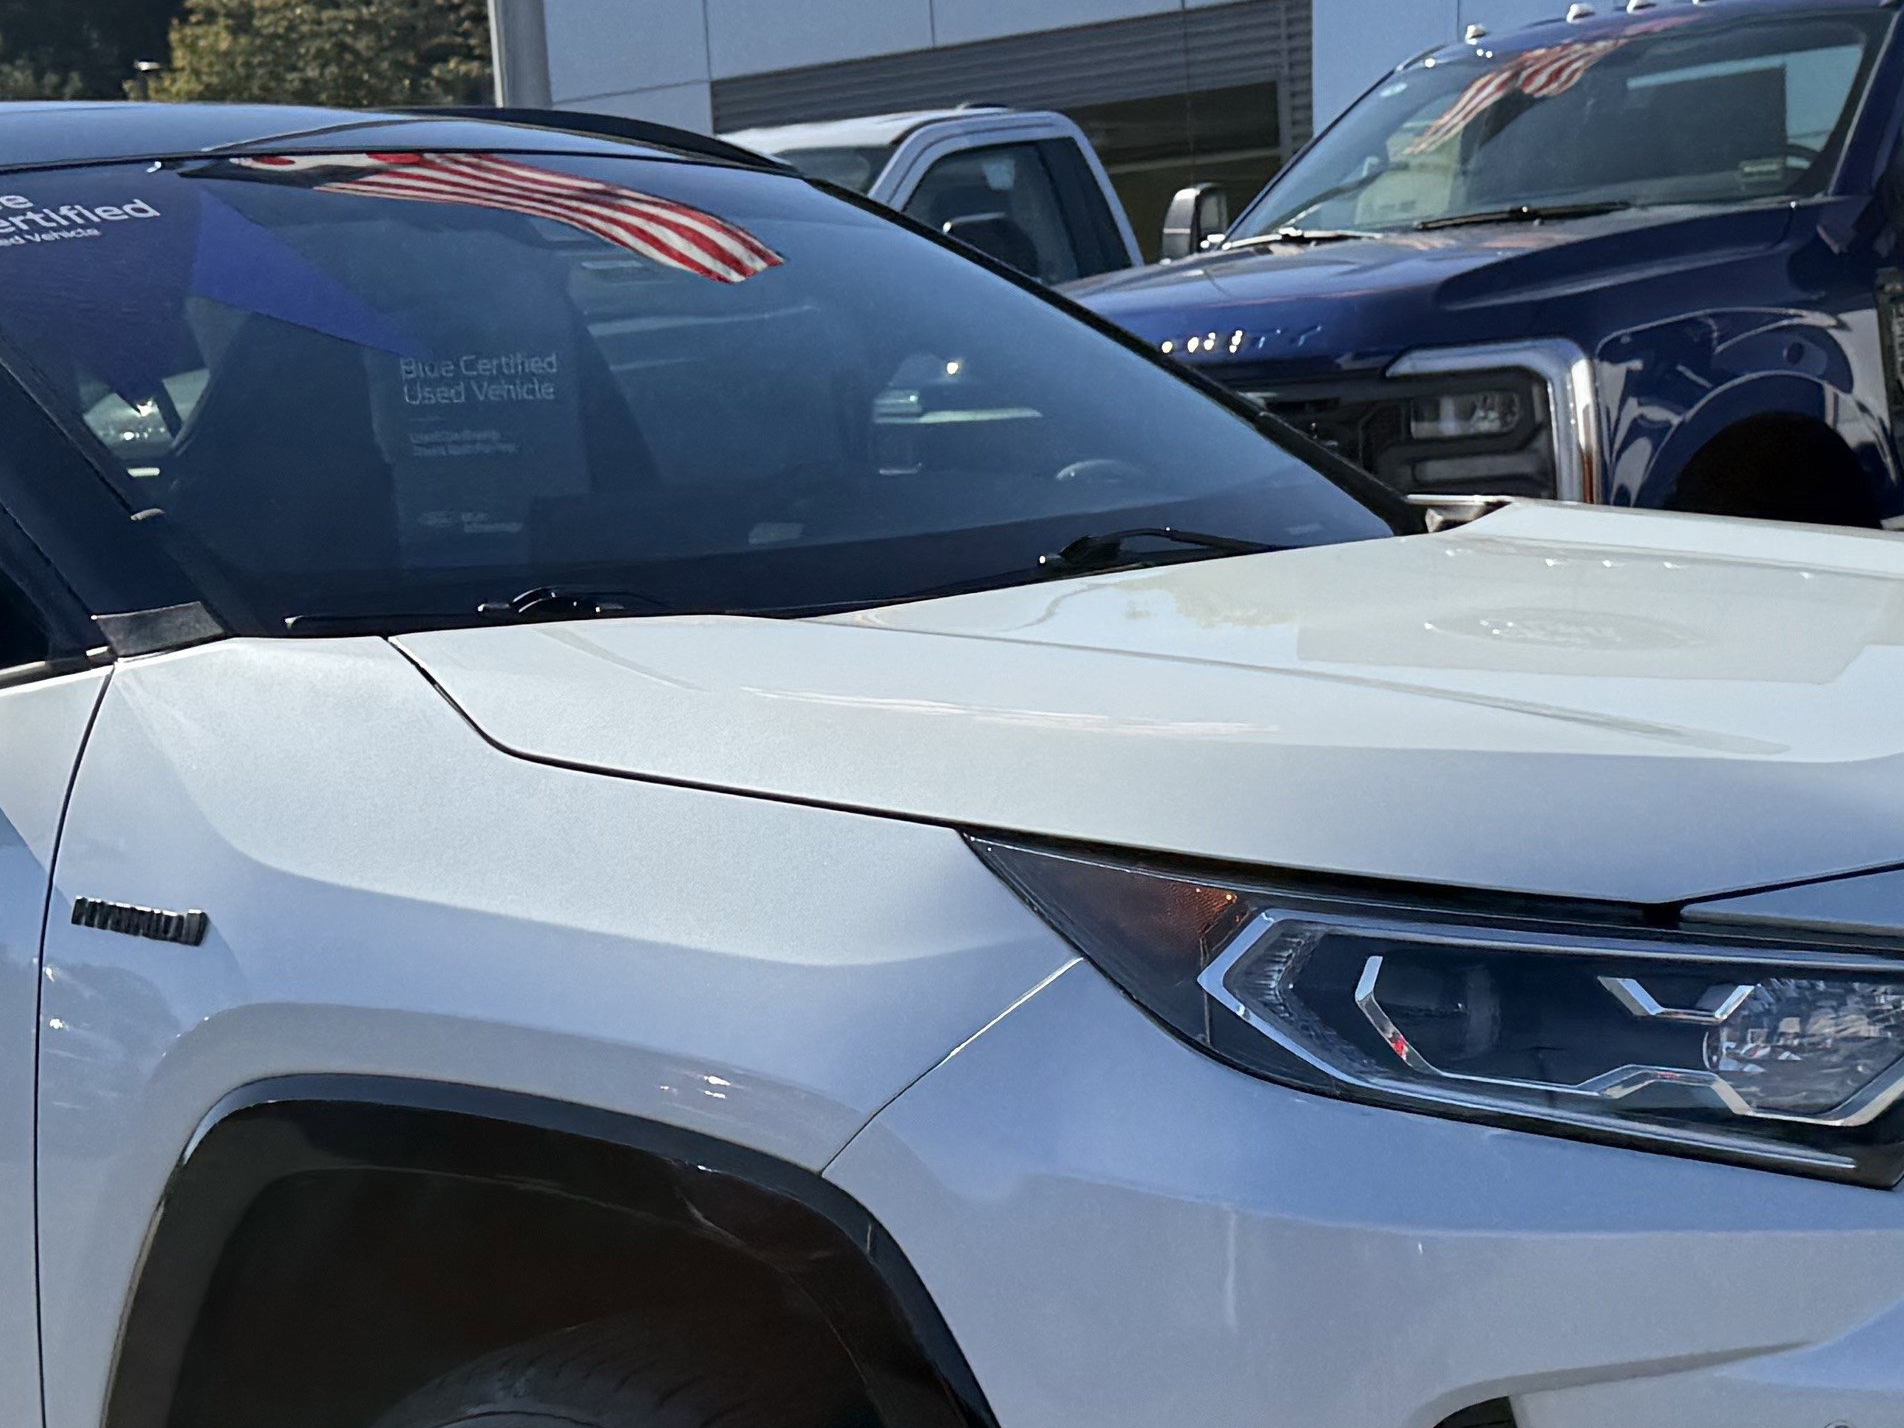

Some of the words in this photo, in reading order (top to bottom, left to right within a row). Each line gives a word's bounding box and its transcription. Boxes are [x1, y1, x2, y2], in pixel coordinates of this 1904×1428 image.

[23, 227, 101, 244] Vehicle
[400, 357, 455, 381] Blue
[460, 352, 557, 375] Certified
[404, 382, 465, 405] Used
[470, 378, 555, 401] Vehicle
